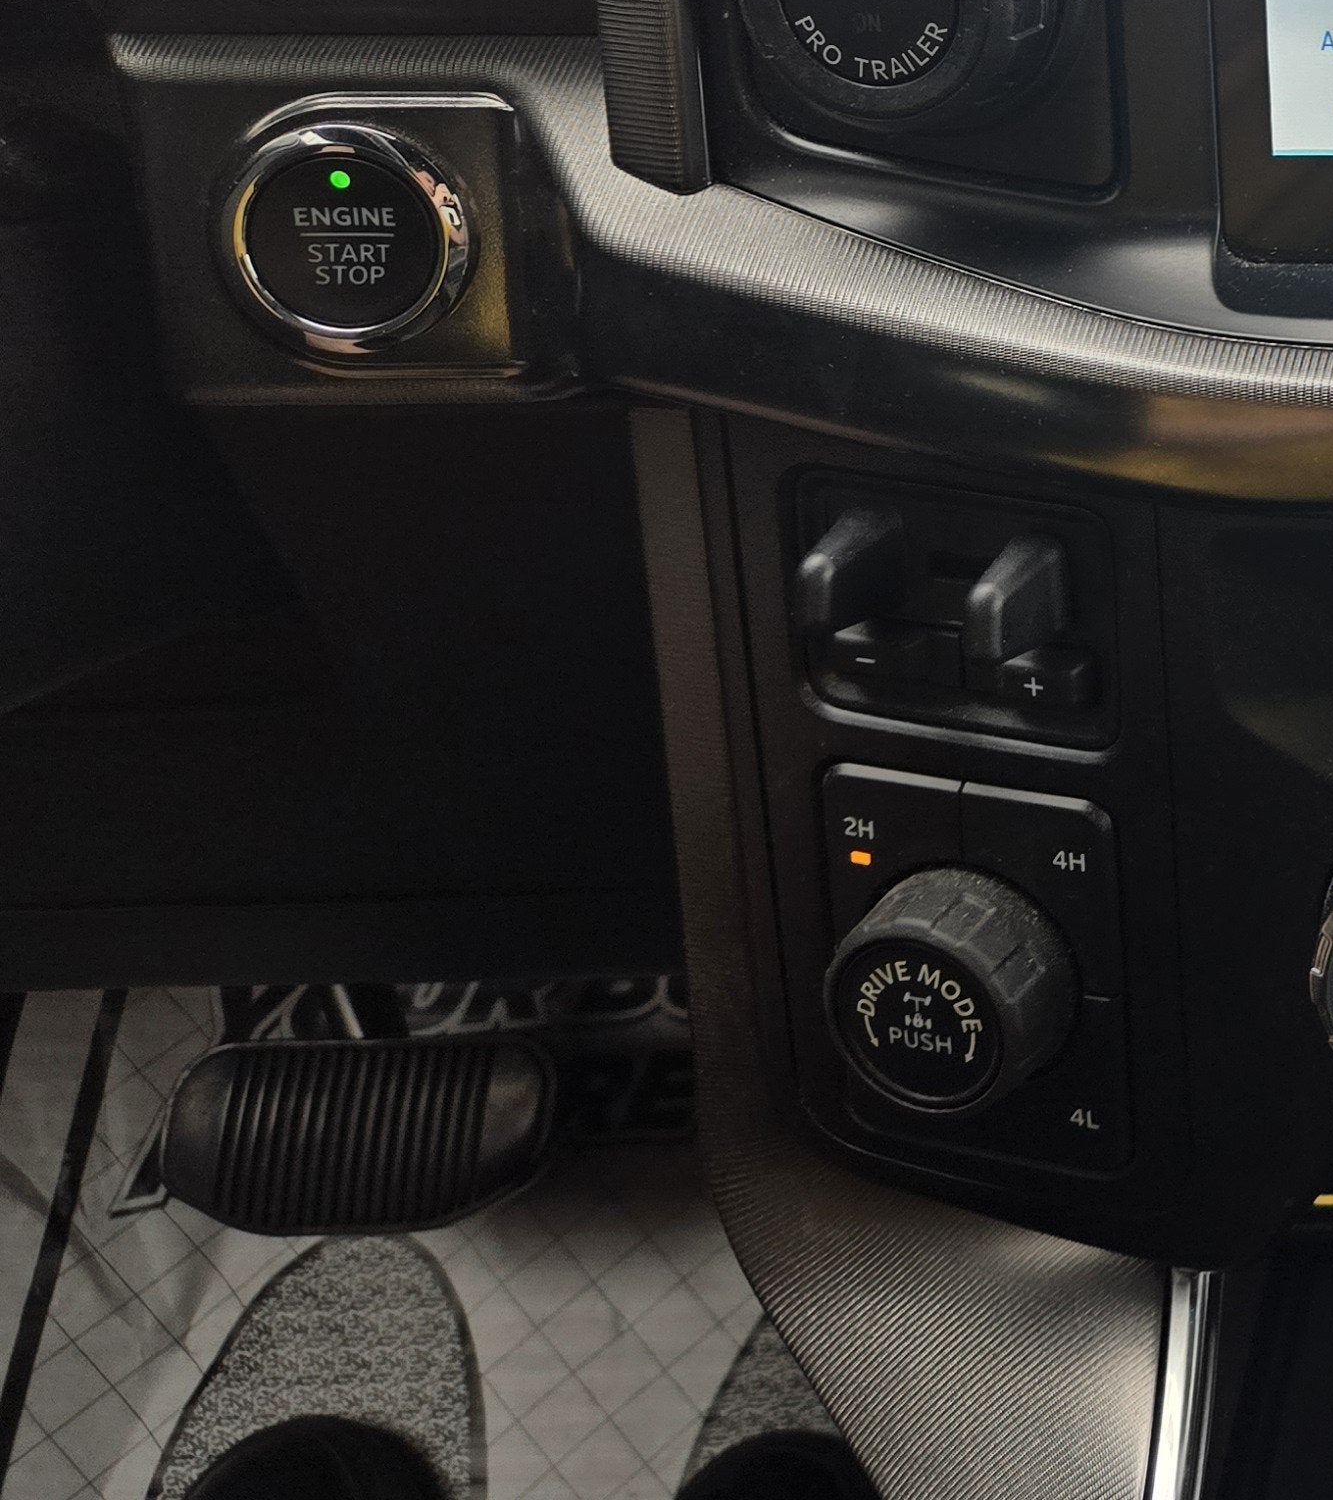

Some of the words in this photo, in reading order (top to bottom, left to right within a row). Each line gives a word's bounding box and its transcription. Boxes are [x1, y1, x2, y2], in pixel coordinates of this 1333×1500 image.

[795, 15, 842, 65] PRO
[854, 21, 948, 81] TRAILER
[294, 207, 396, 227] ENGINE
[308, 244, 391, 264] START
[315, 265, 386, 286] STOP
[844, 817, 875, 839] 2H
[1053, 852, 1086, 872] 4H
[857, 960, 911, 1018] DRIVE
[917, 963, 982, 1033] MODE
[889, 1027, 952, 1055] PUSH
[1070, 1108, 1100, 1130] 4L
